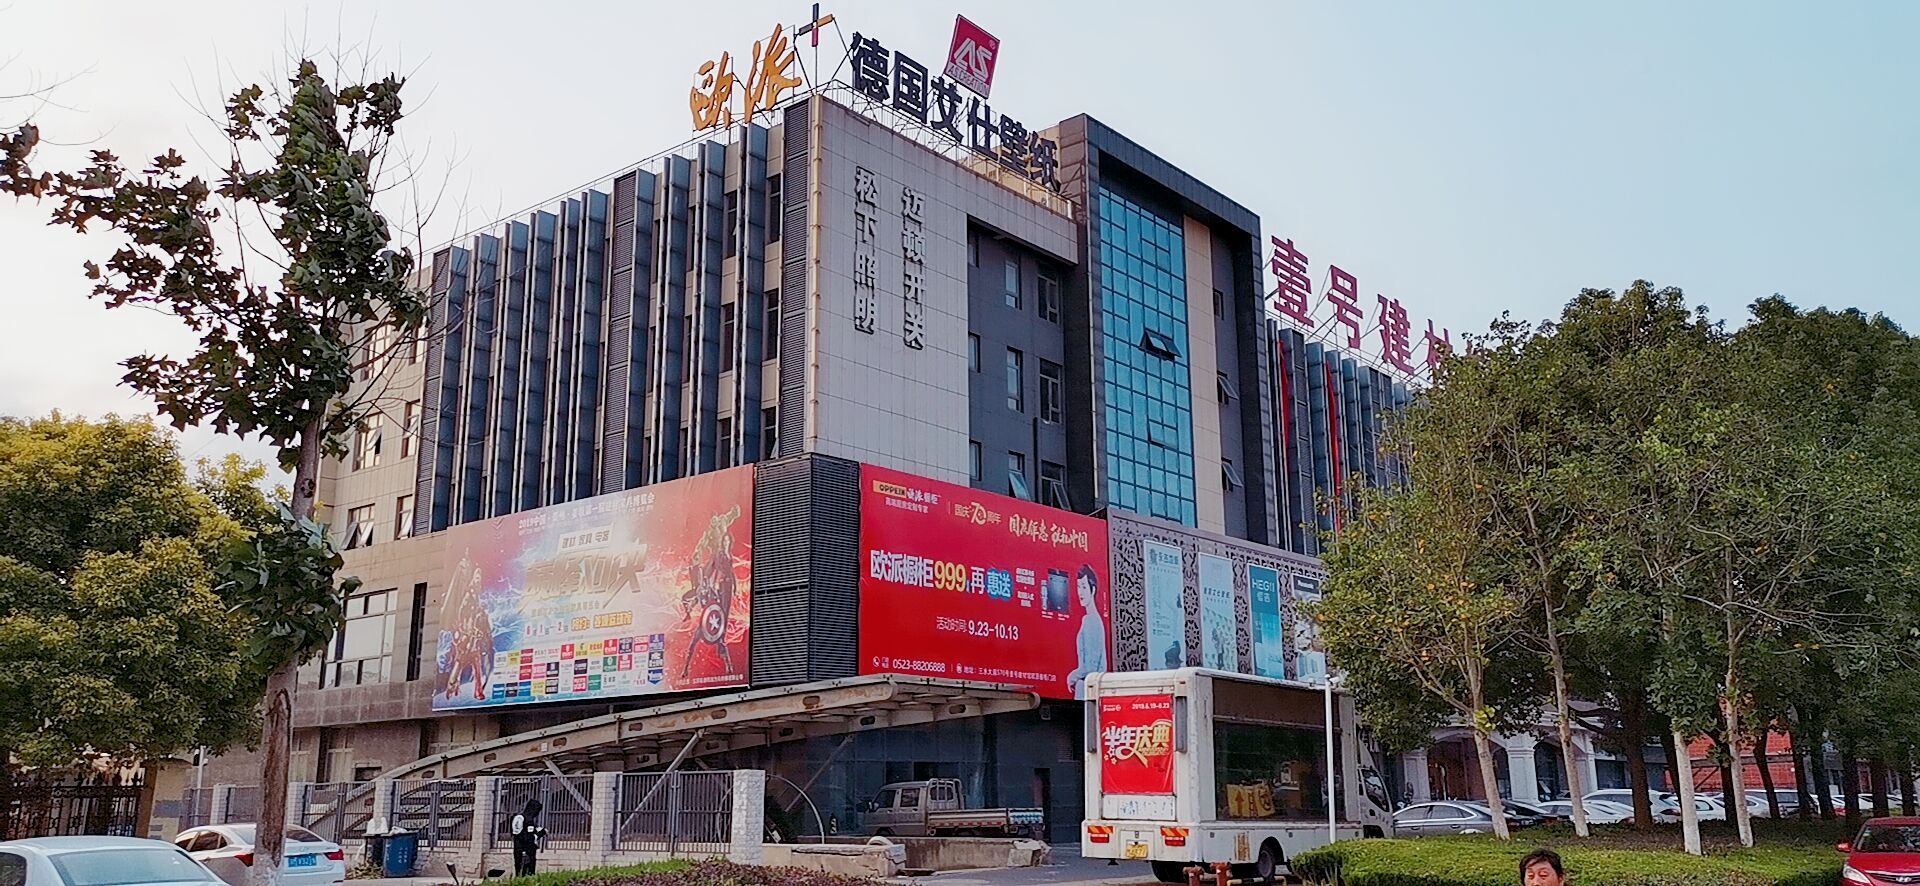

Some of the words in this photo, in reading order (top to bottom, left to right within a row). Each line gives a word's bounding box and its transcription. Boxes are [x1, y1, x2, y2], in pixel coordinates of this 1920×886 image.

[851, 31, 1061, 192] 德国艾仕壁纸
[855, 166, 878, 333] 松下照明
[879, 483, 906, 497] OPPEIN
[1103, 720, 1172, 762] 半年庆典
